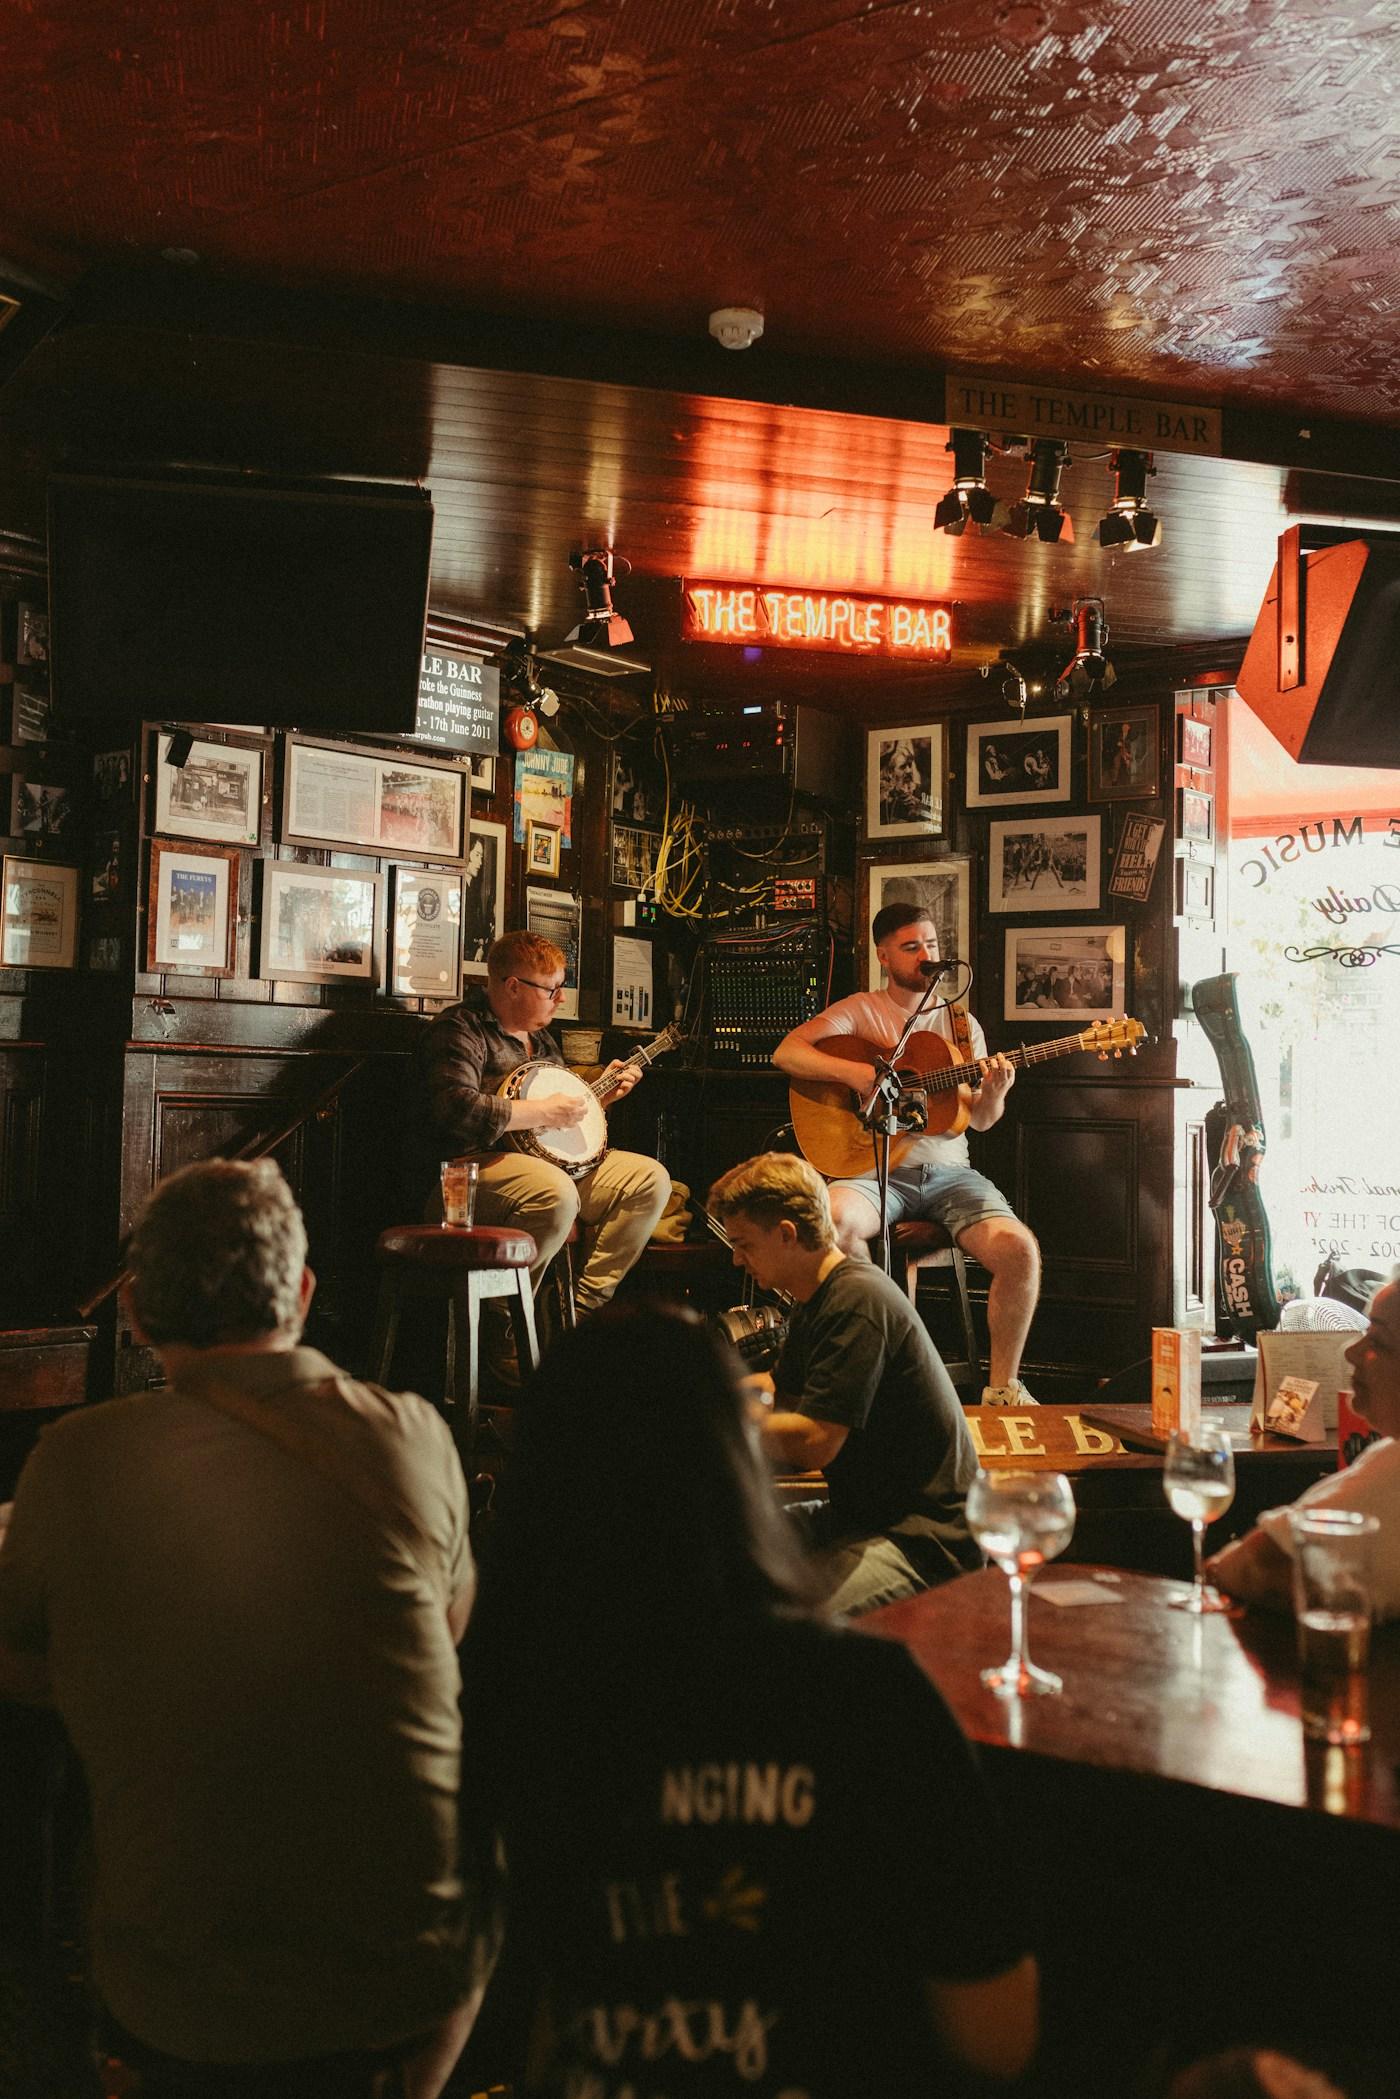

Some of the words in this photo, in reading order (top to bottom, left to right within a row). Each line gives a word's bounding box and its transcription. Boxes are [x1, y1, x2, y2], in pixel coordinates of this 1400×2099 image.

[959, 388, 1017, 420] THE
[1032, 397, 1142, 435] TEMPLE
[1155, 412, 1209, 443] BAR
[693, 589, 757, 632] THE
[765, 592, 884, 645] TEMPLE
[892, 604, 951, 651] BAR
[446, 660, 482, 684] BAR
[436, 680, 449, 695] the
[449, 683, 483, 702] Guinness
[444, 699, 472, 720] playing
[473, 706, 494, 721] guitar
[430, 716, 448, 732] 17th
[450, 719, 470, 736] June
[471, 723, 491, 740] 2011
[523, 751, 550, 772] JOHNNY
[1228, 1258, 1254, 1318] CASH
[965, 1416, 1046, 1455] LE
[1063, 1416, 1129, 1455] B
[662, 1761, 815, 1828] NGING
